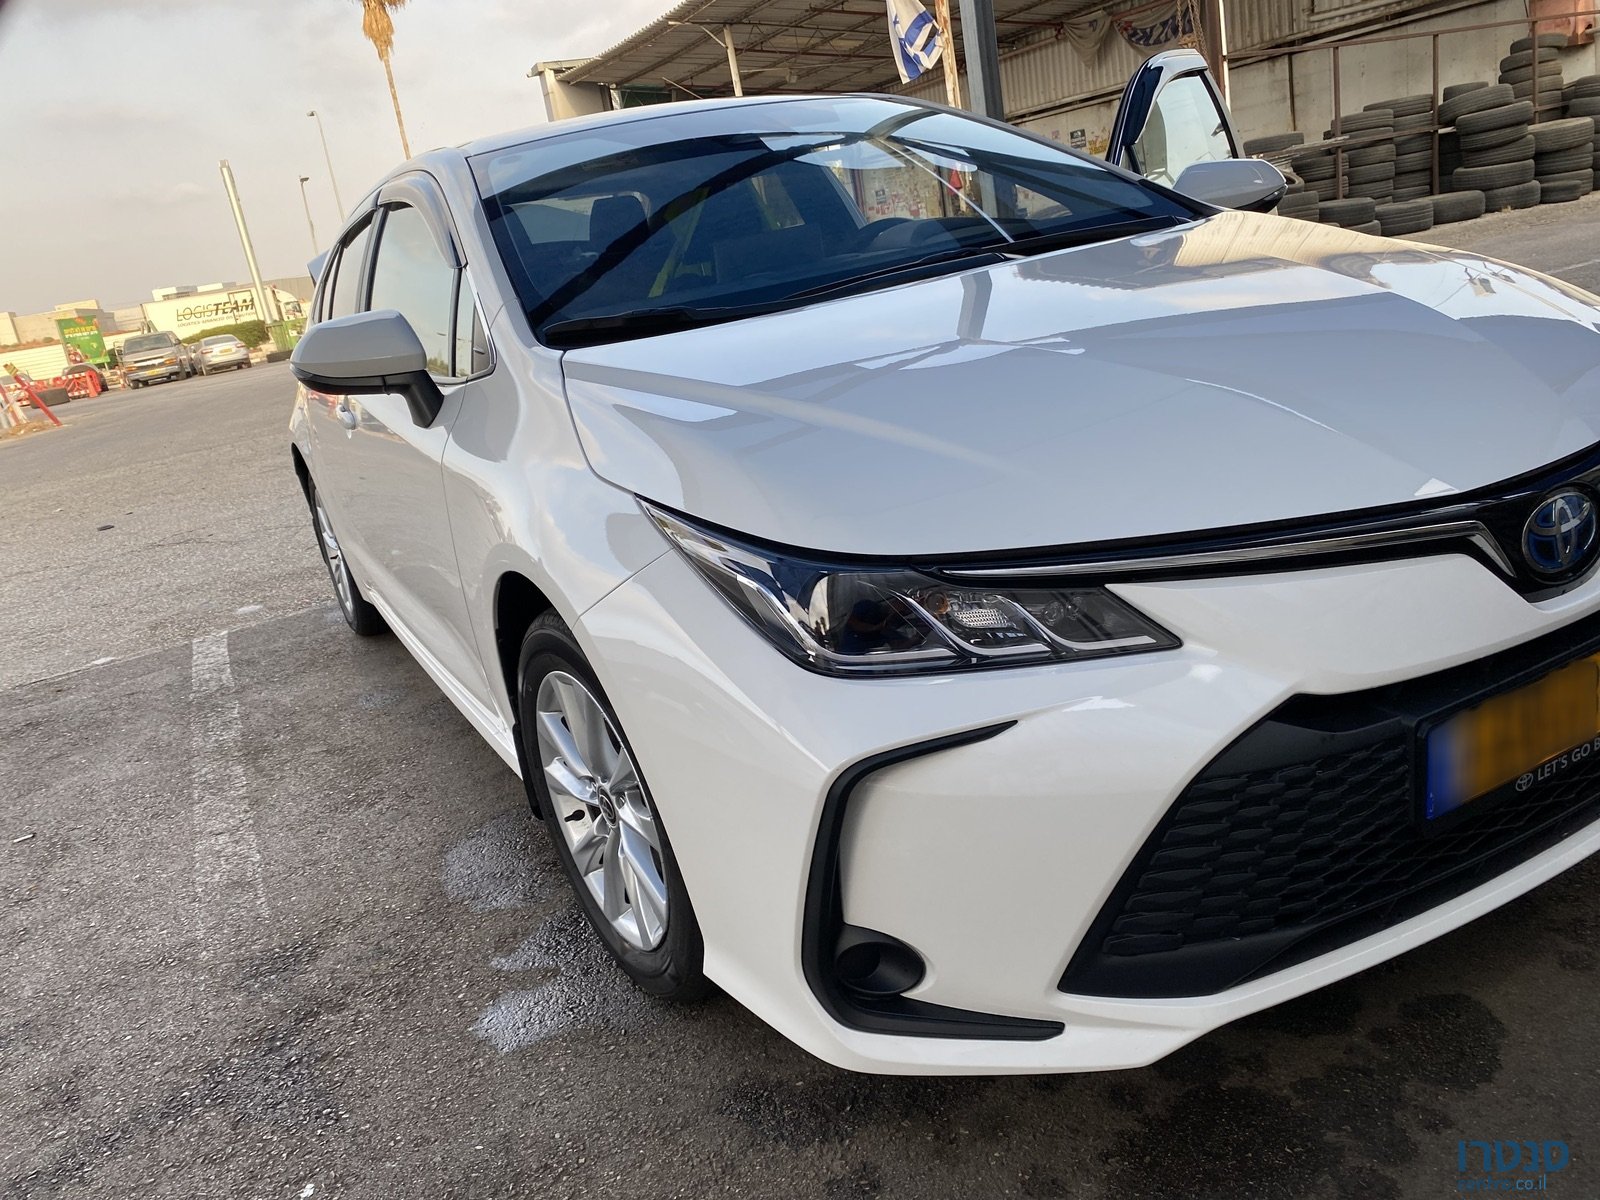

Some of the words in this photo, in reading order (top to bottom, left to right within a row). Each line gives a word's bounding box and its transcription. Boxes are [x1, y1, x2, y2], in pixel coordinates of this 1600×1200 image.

[176, 297, 255, 322] LOGISTEAM
[1537, 755, 1568, 781] LET'S
[1571, 743, 1591, 762] GO
